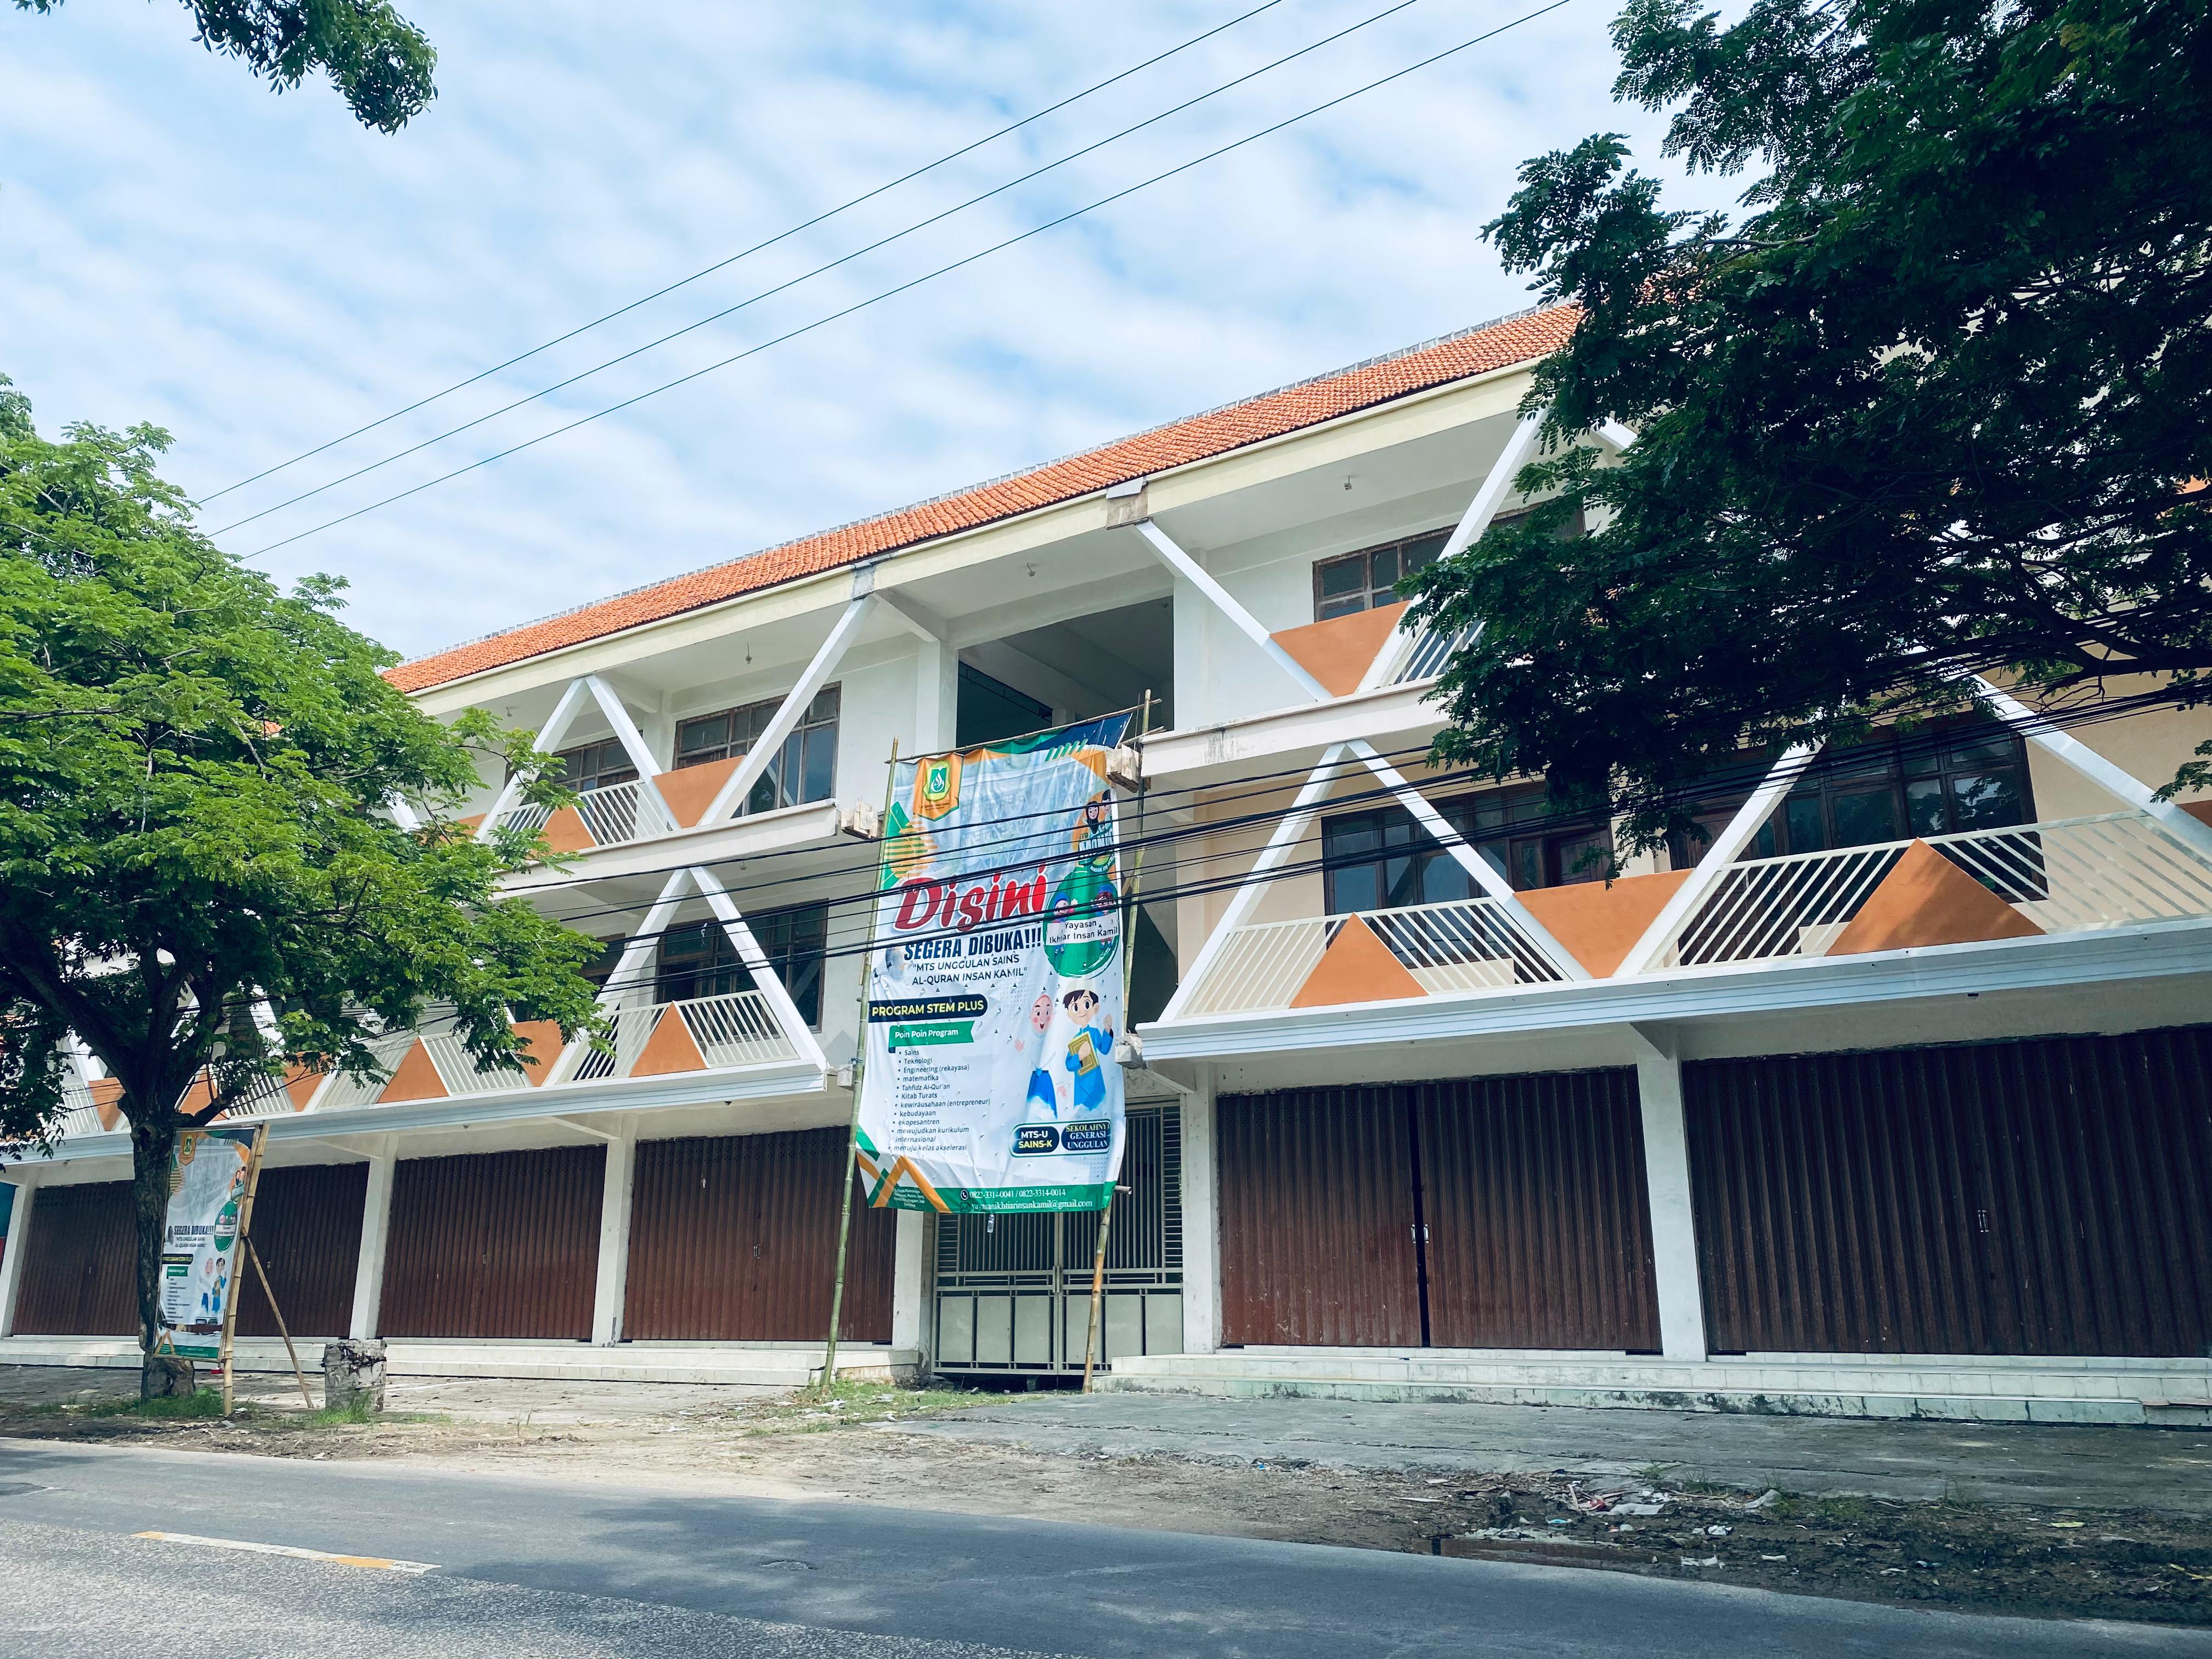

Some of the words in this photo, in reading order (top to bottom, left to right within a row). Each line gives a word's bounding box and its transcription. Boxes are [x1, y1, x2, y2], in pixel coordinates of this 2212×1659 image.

[894, 862, 1048, 933] Disini
[1065, 921, 1097, 930] Yayasan
[1097, 927, 1118, 937] Kamil
[904, 938, 961, 961] SEGERA
[968, 927, 1041, 956] DIBUKA!!!
[913, 963, 935, 972] "MTS
[938, 958, 990, 970] UNGGULAN
[992, 954, 1019, 966] SAINS
[912, 974, 961, 986] AL-QURAN
[962, 970, 992, 981] INSAN
[994, 967, 1028, 979] KAMIL"
[872, 1004, 924, 1017] PROGRAM
[927, 1002, 955, 1013] STEM
[958, 1000, 984, 1011] PLUS
[895, 1030, 910, 1039] Poin
[911, 1030, 927, 1038] Poin
[928, 1029, 958, 1038] Program
[947, 1098, 990, 1107] (entrepreneur)
[1021, 1131, 1048, 1139] MTS-U
[1070, 1131, 1107, 1139] GENERASI
[1018, 1139, 1053, 1149] SAINS-K
[1019, 1188, 1066, 1198] 0822-3314-0014
